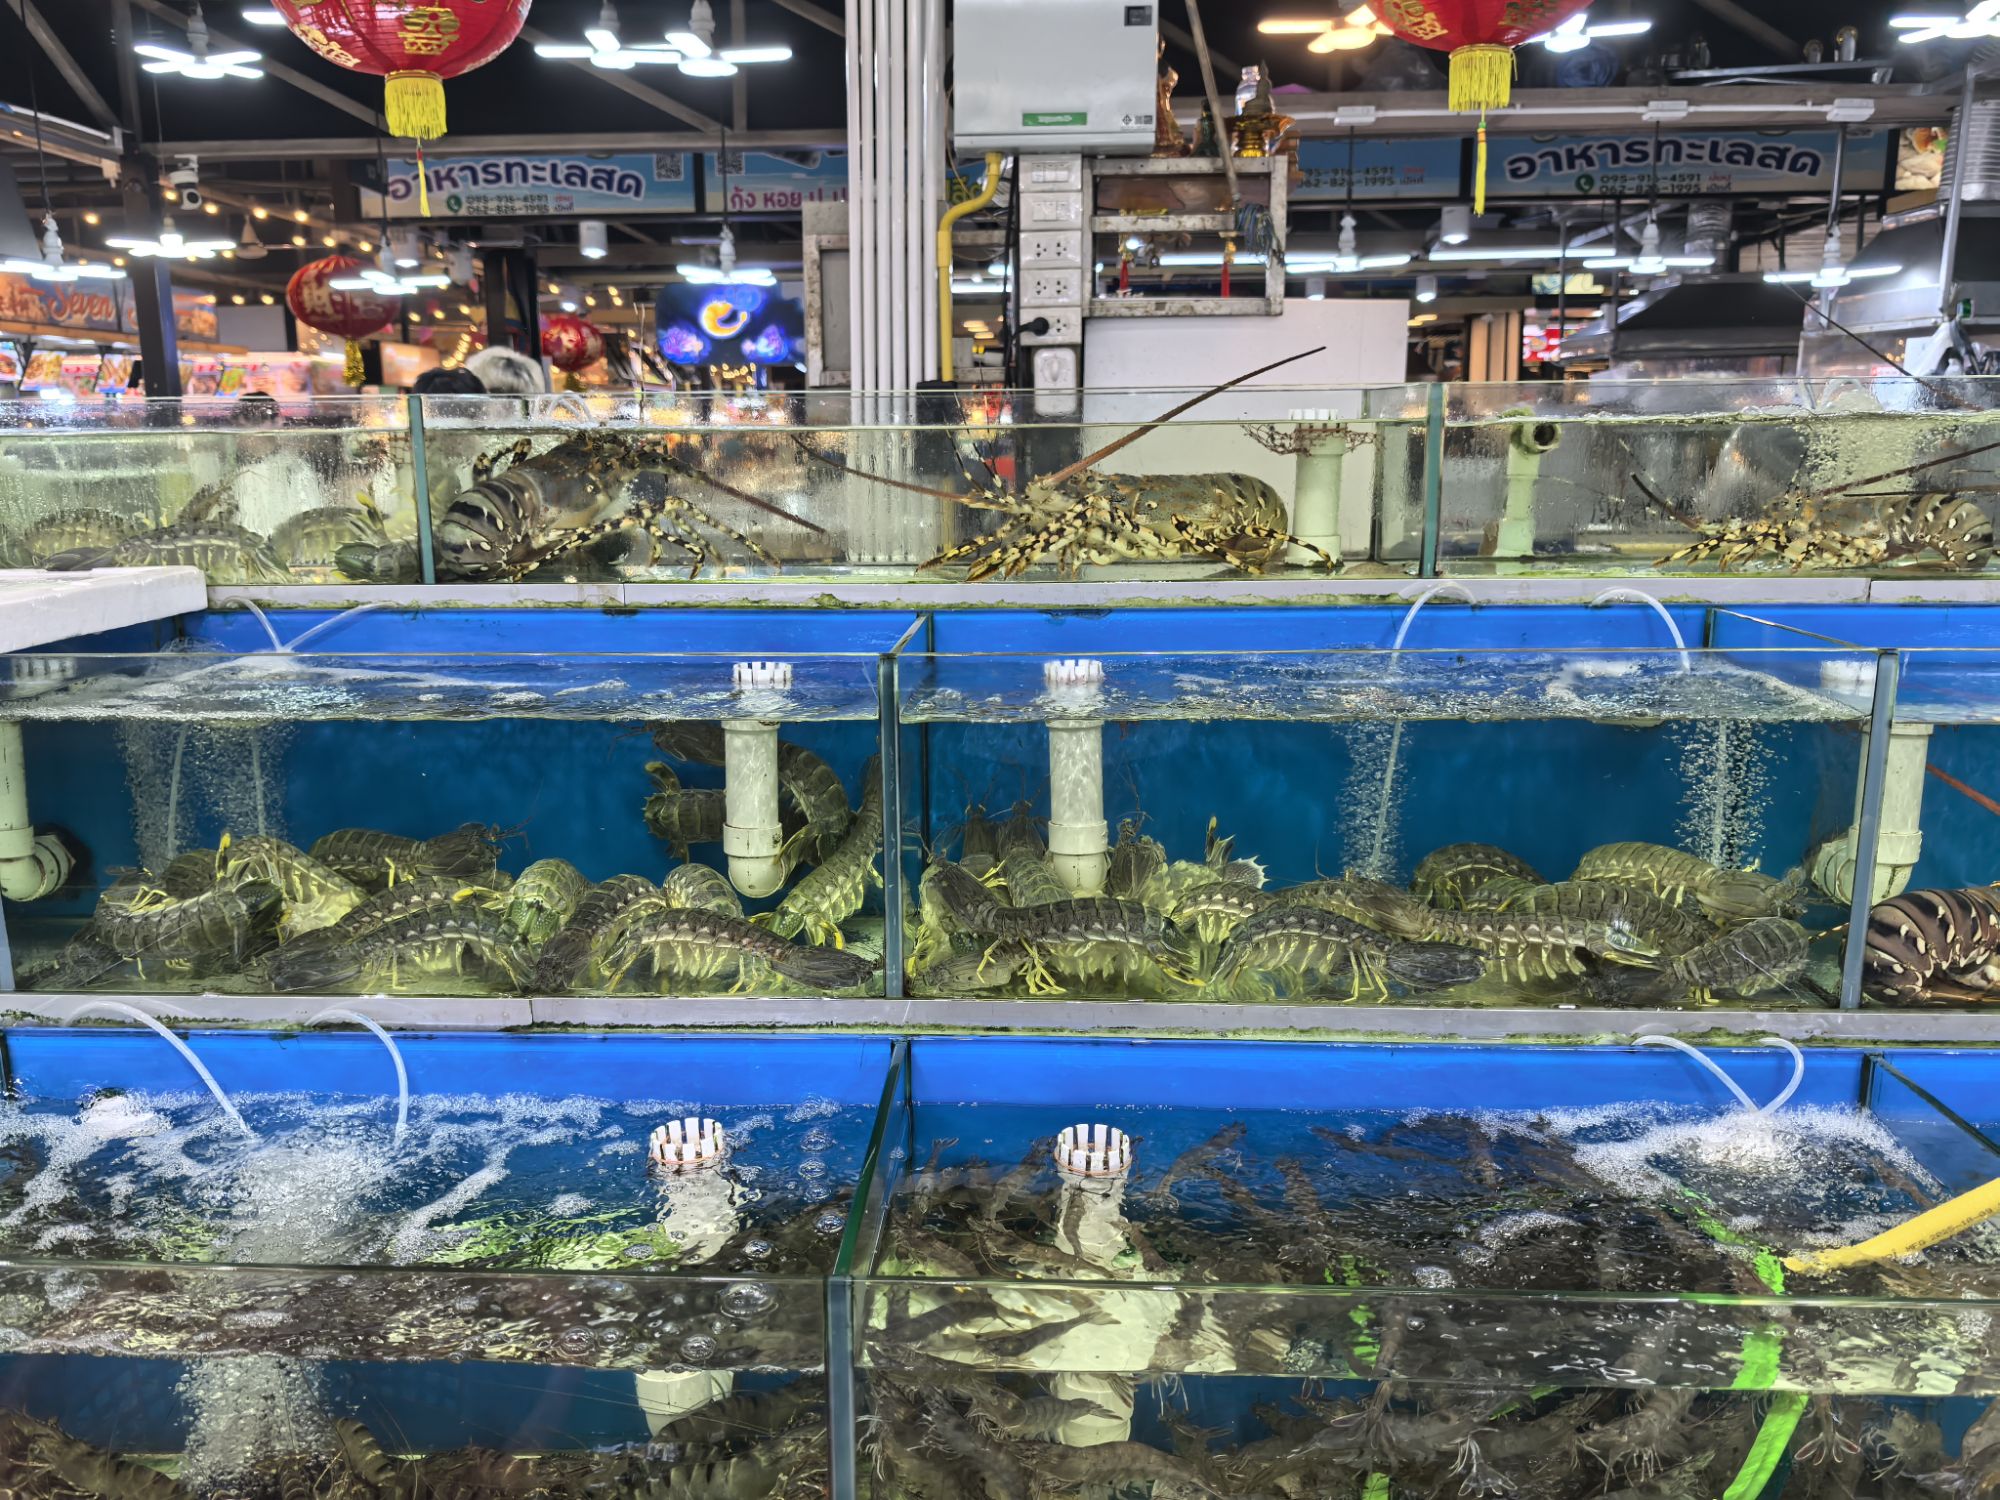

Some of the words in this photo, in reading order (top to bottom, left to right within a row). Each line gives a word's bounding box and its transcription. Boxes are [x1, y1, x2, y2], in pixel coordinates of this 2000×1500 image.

[1507, 138, 1820, 180] อาหารทะเลสด
[388, 160, 642, 200] อาหารทะเลสด
[730, 184, 757, 210] ก้ง
[49, 285, 117, 321] Seven
